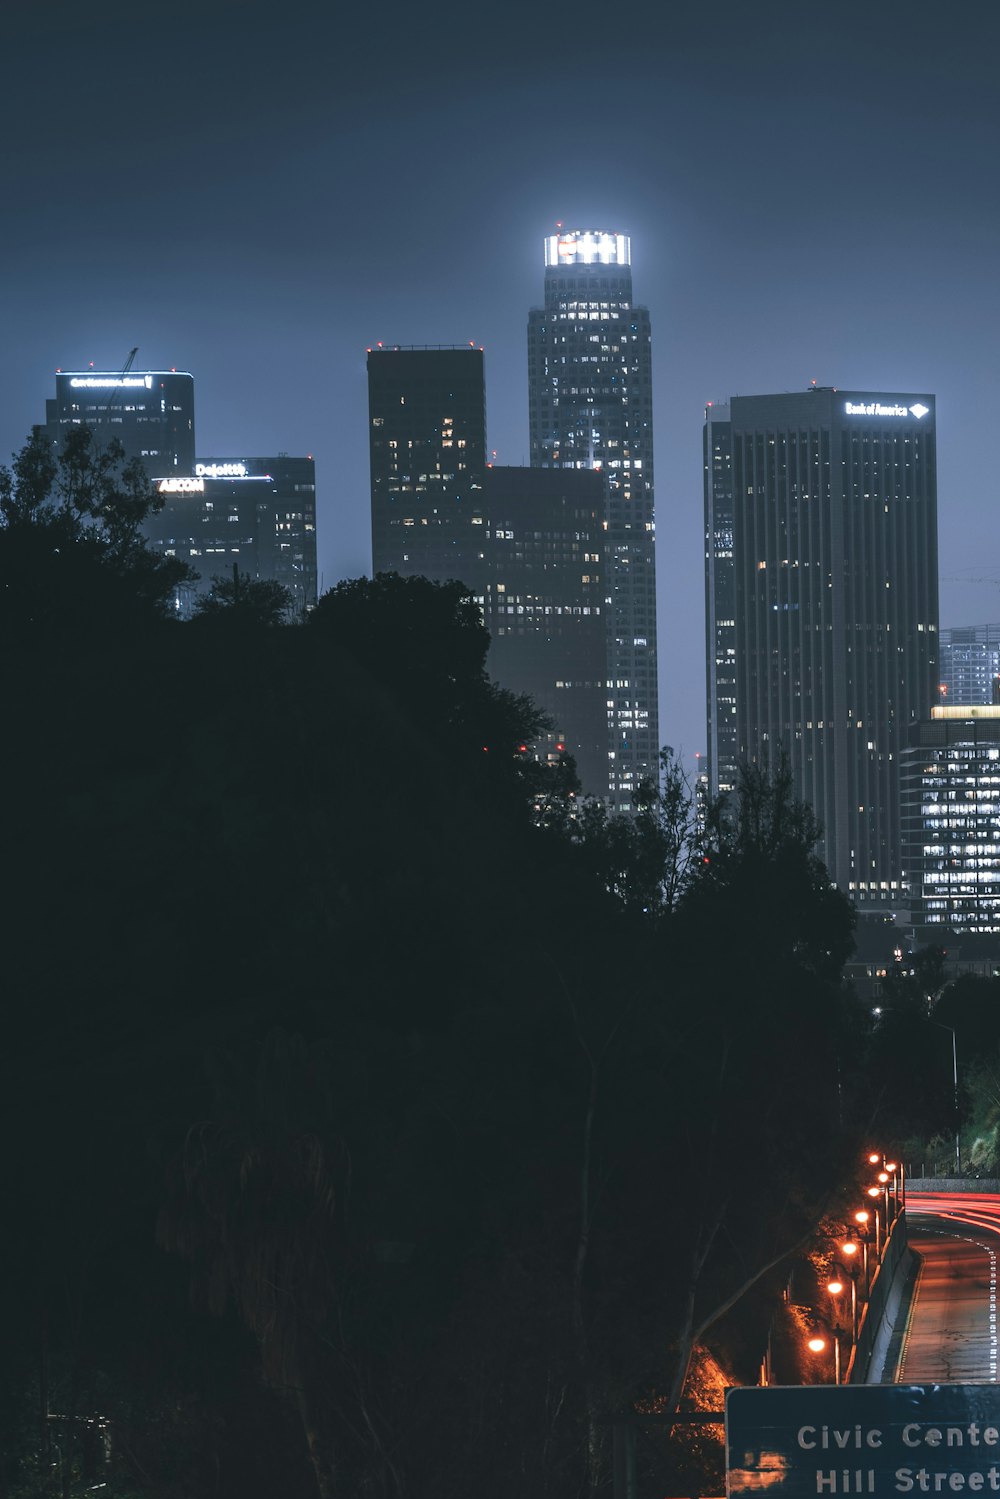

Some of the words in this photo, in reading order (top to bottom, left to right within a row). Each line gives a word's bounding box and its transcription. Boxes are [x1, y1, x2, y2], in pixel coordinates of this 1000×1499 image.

[845, 402, 866, 414] Bank
[866, 403, 875, 415] of
[875, 403, 908, 416] America
[159, 479, 204, 492] AECOM
[797, 1425, 883, 1449] Civic
[816, 1469, 875, 1493] Hill
[895, 1466, 1000, 1492] Street
